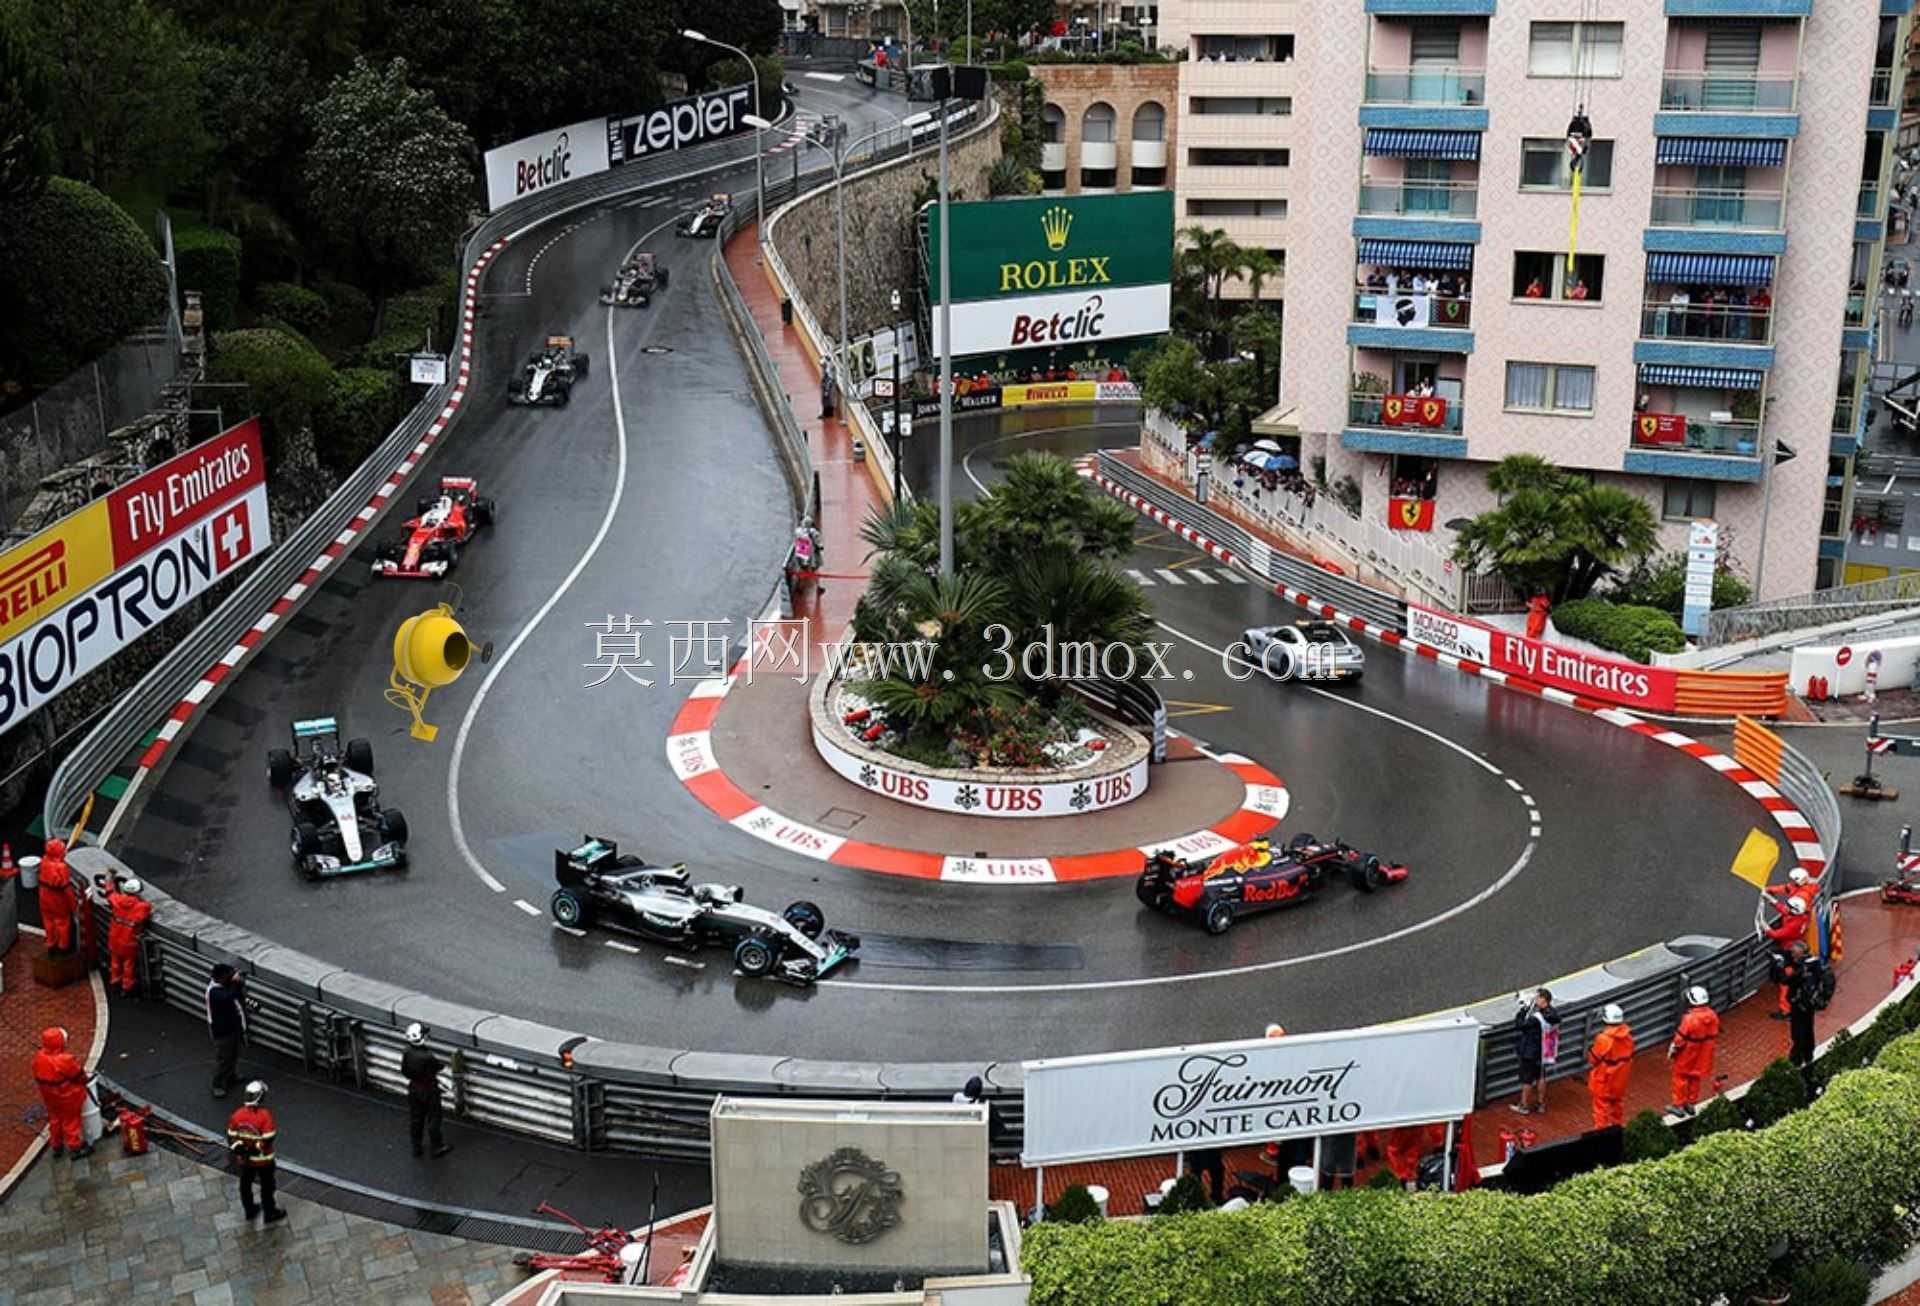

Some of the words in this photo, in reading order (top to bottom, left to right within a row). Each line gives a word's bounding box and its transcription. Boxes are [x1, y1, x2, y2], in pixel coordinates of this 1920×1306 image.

[622, 90, 749, 154] zepter
[516, 141, 571, 196] Betclic
[1000, 256, 1112, 291] ROLEX
[1011, 303, 1105, 346] Betclic
[127, 491, 164, 541] Fly
[166, 443, 251, 518] Emirates
[0, 538, 67, 626] RELLI
[1412, 611, 1458, 640] MONACO
[1505, 636, 1537, 674] Fly
[1542, 648, 1649, 697] Emirates
[880, 771, 929, 801] UBS
[985, 787, 1043, 812] UBS
[1095, 771, 1132, 806] UBS
[774, 824, 828, 851] UBS
[986, 862, 1046, 877] UBS
[1153, 1053, 1361, 1119] Fairmont
[1150, 1113, 1254, 1142] MONTE
[1265, 1102, 1361, 1130] CARLO
